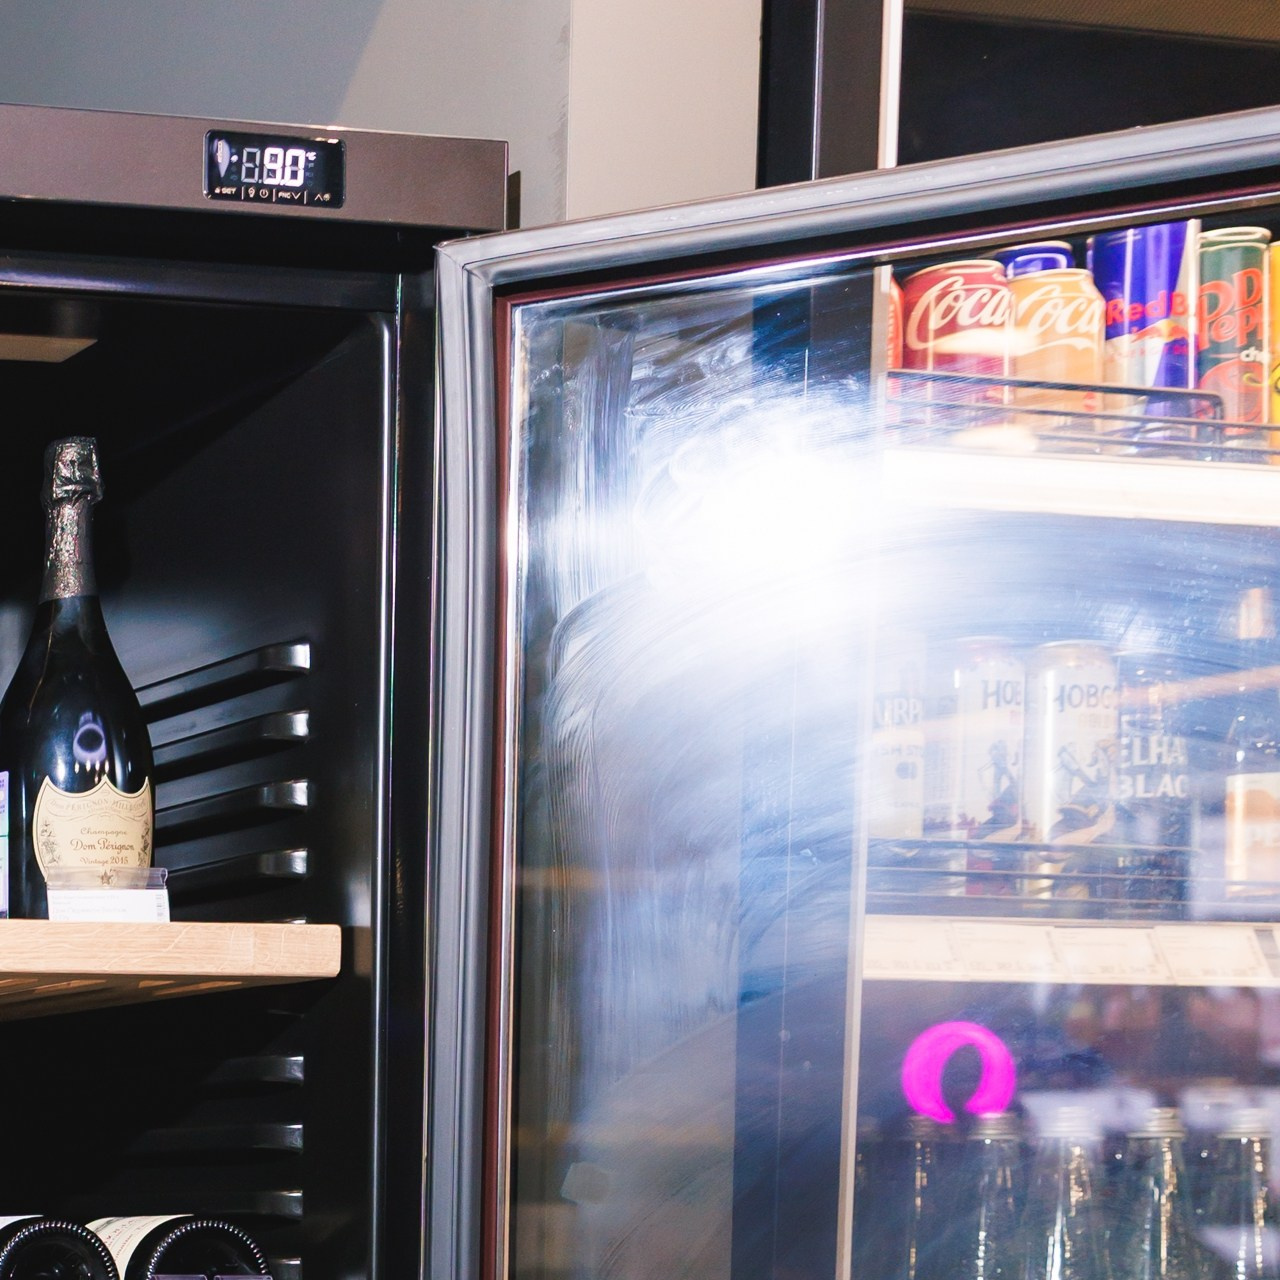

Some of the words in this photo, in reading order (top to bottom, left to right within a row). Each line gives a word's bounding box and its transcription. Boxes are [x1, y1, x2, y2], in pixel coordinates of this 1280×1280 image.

[79, 827, 128, 838] Champagne
[70, 838, 96, 851] Dom
[97, 838, 135, 854] Pérignon
[79, 856, 109, 866] Vintage
